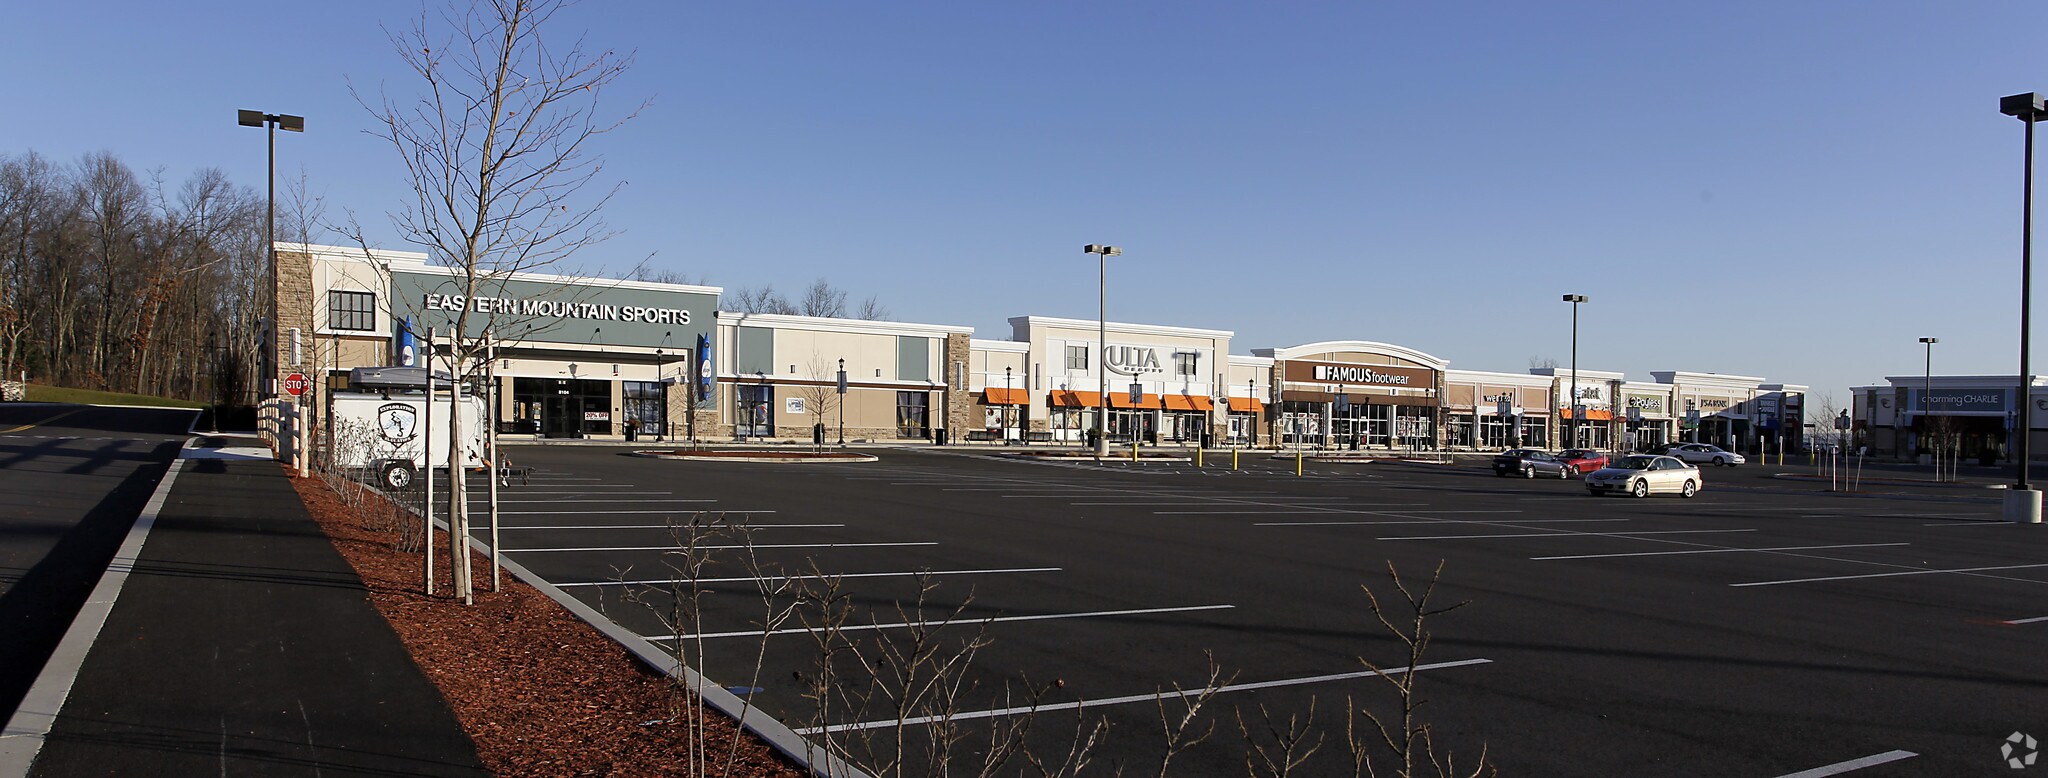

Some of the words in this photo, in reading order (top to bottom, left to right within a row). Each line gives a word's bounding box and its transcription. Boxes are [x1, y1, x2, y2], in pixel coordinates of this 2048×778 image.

[522, 299, 617, 321] MOUNTAIN
[621, 305, 691, 325] SPORTS
[1109, 345, 1161, 368] ULTA
[1326, 366, 1371, 382] FAMOUS
[1371, 371, 1409, 384] footwear
[286, 380, 308, 389] STOP
[1964, 395, 1998, 403] CHARLIE
